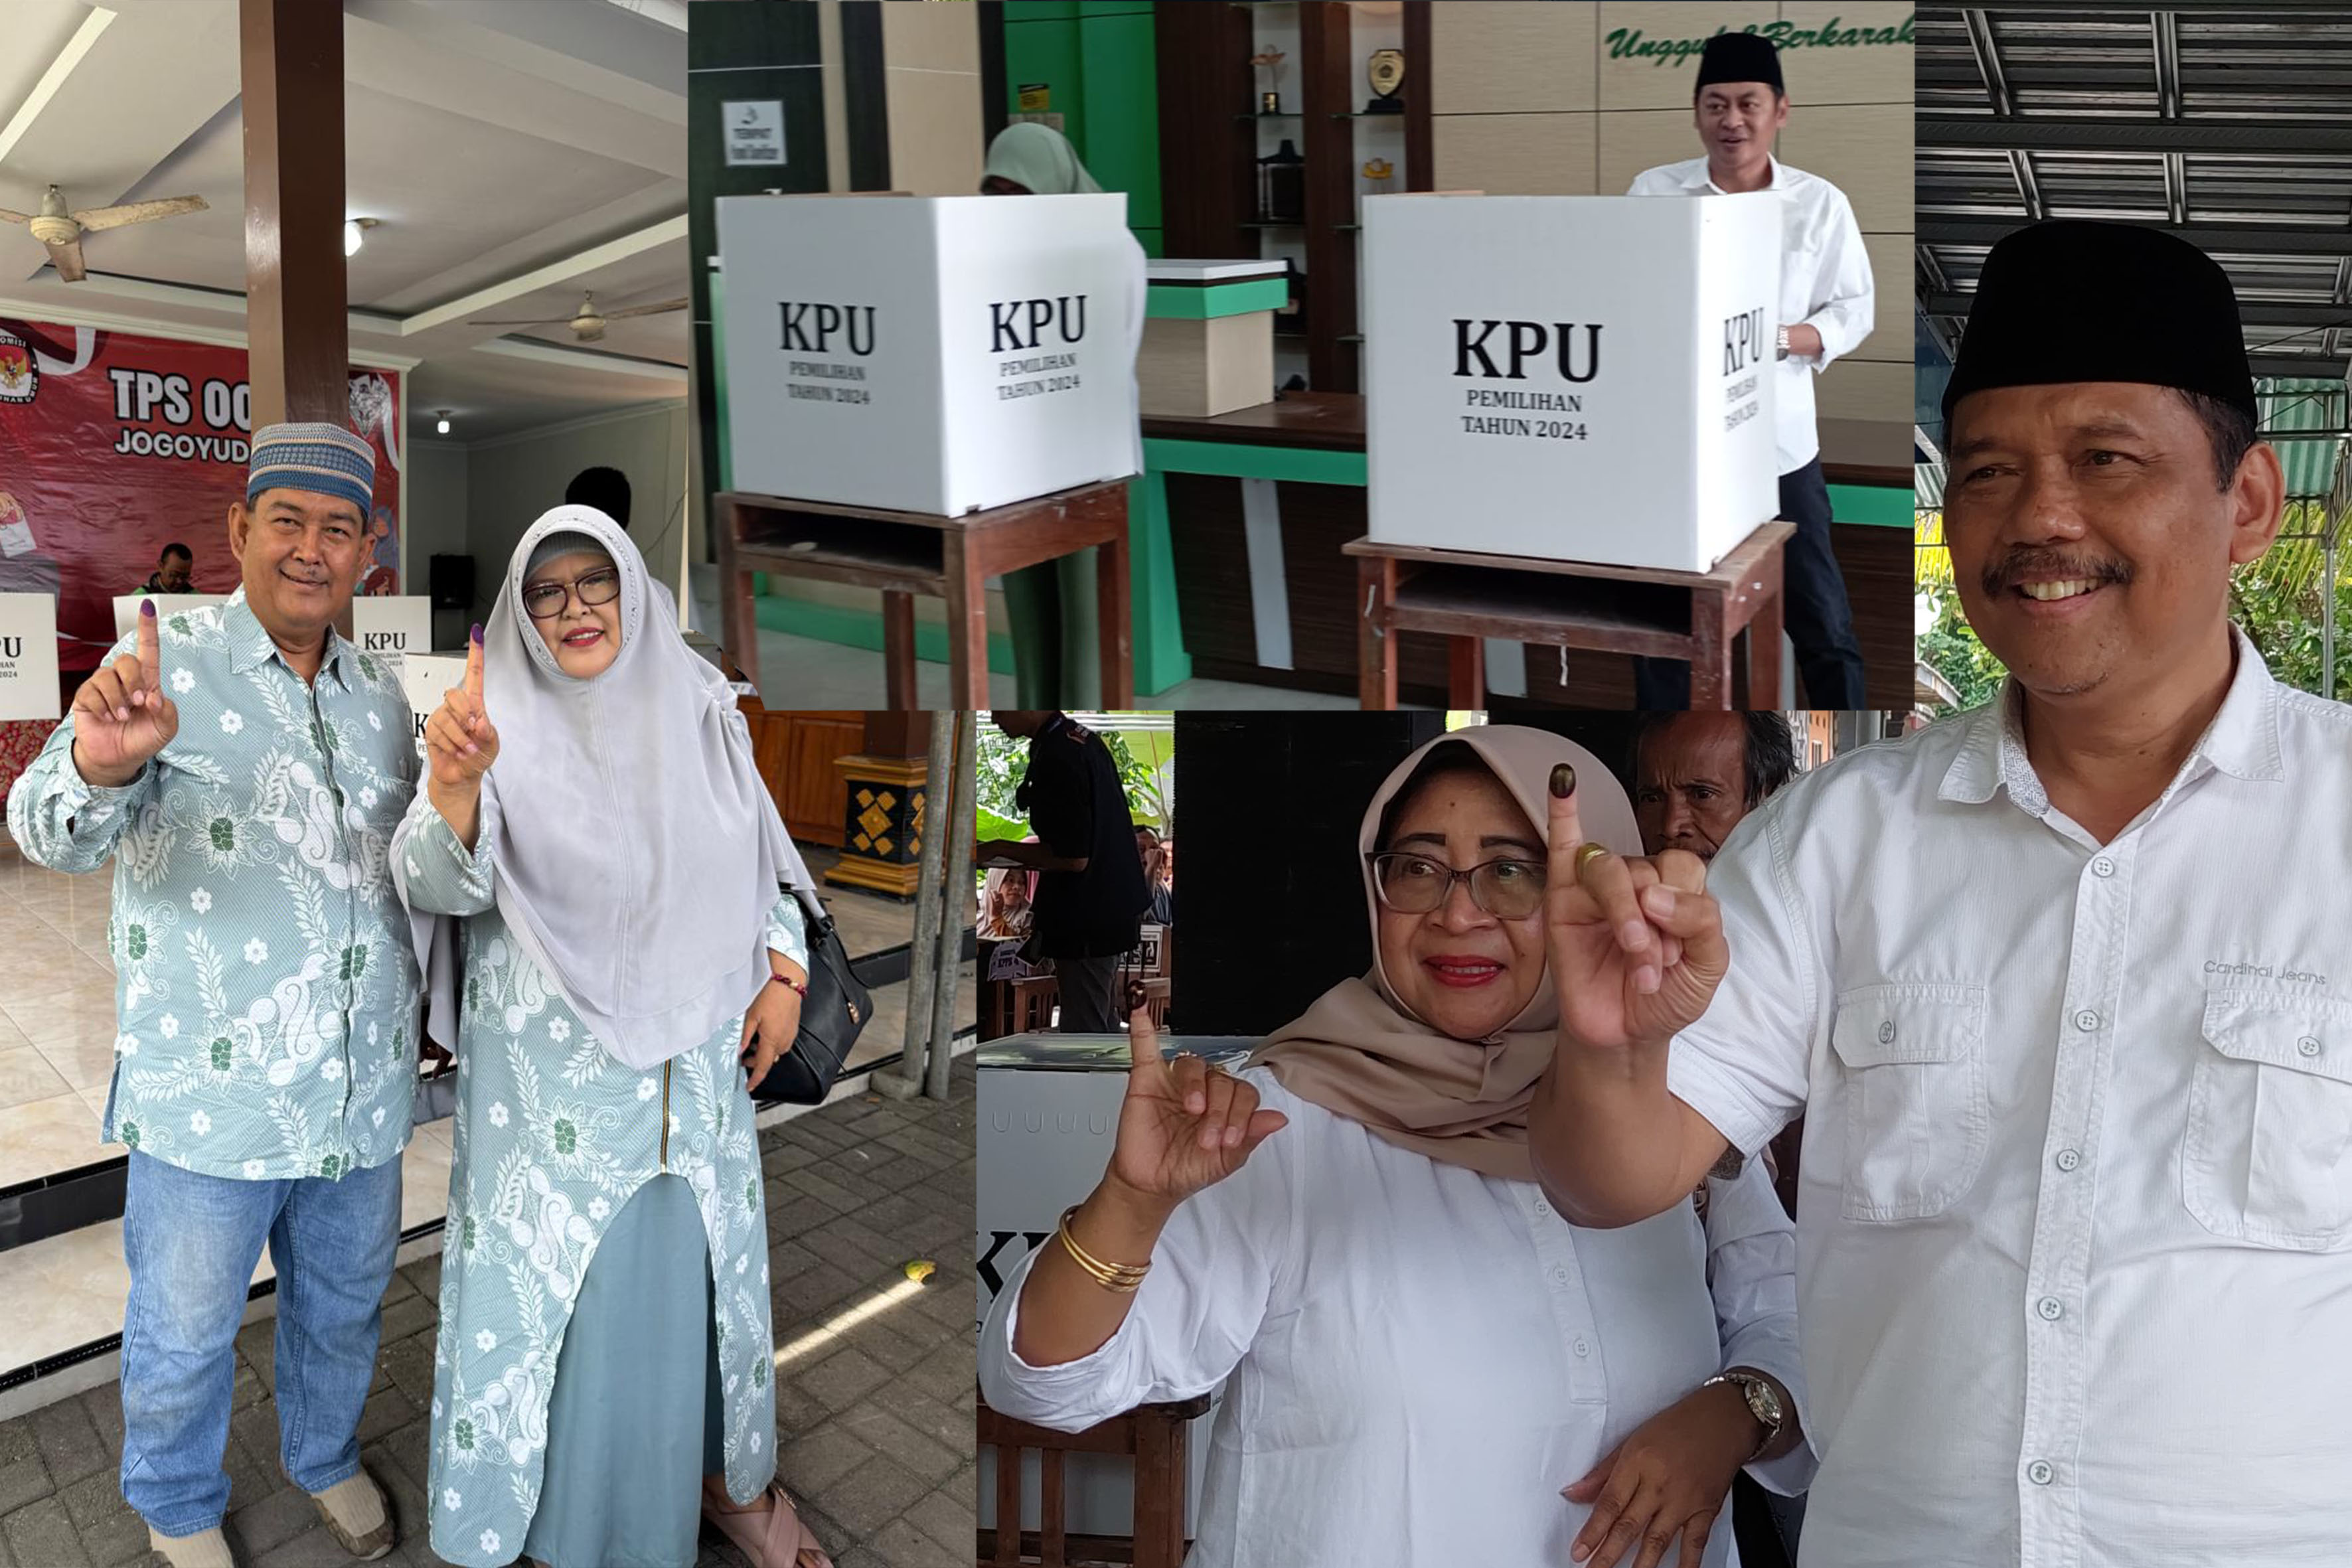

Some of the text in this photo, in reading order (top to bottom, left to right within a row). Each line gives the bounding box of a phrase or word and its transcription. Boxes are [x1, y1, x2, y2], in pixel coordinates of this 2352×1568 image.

[1605, 25, 1727, 66] Unggu
[779, 301, 876, 356] KPU
[989, 295, 1087, 353] KPU
[1723, 307, 1764, 376] KPU
[1452, 319, 1604, 383] KPU
[109, 368, 191, 425] TPS
[1466, 389, 1583, 412] PEMILIHAN
[114, 430, 250, 463] JOGOYUD
[1460, 416, 1589, 440] TAHUN 2024
[364, 633, 406, 650] KPU
[2203, 961, 2326, 984] Cardinal Jeans
